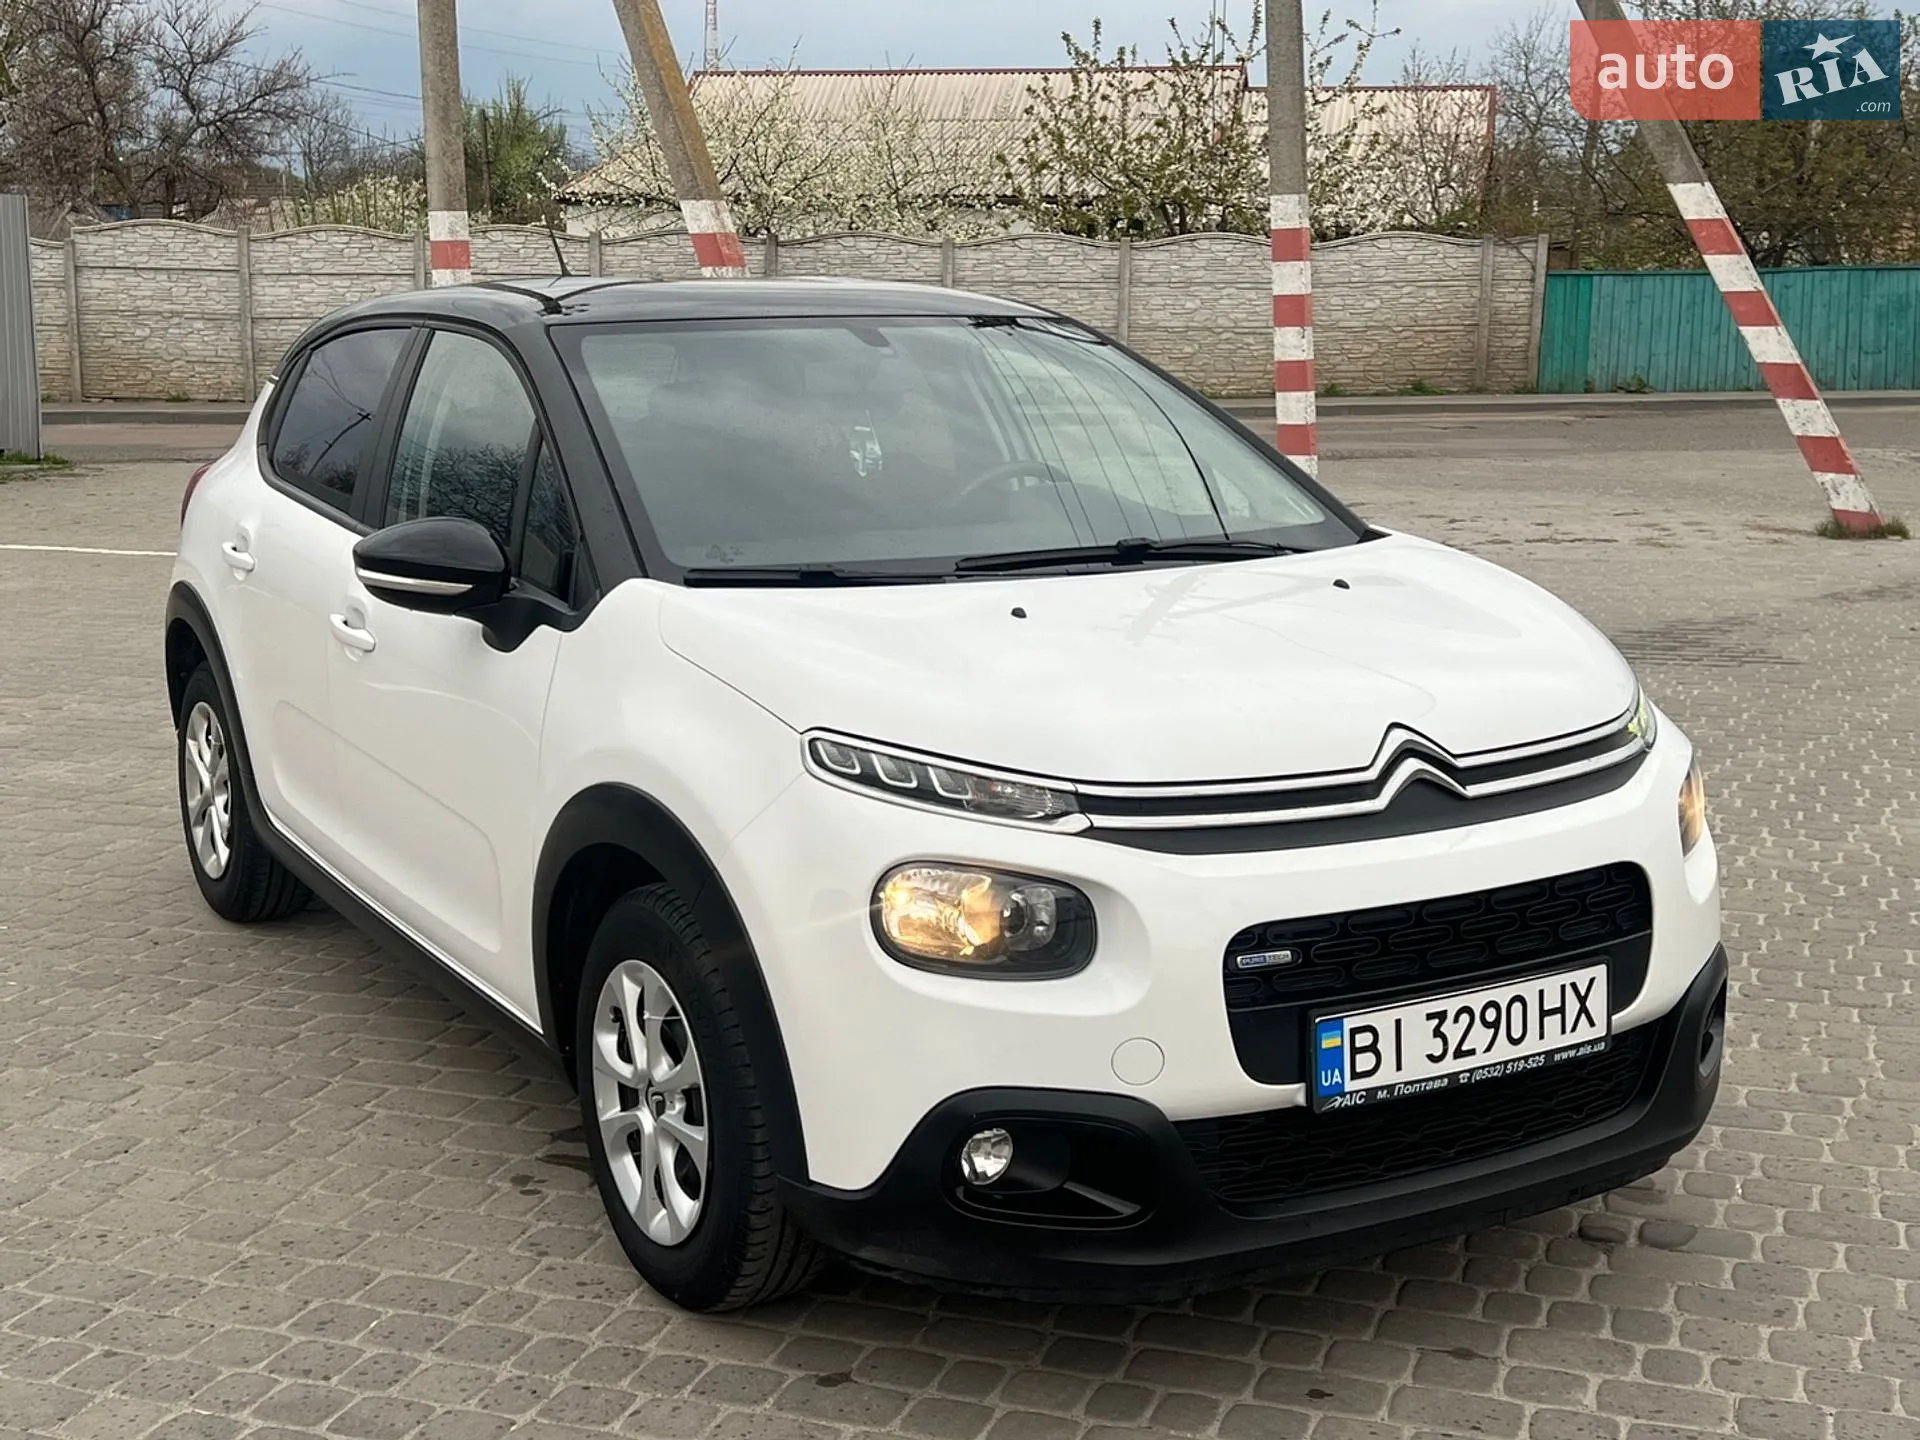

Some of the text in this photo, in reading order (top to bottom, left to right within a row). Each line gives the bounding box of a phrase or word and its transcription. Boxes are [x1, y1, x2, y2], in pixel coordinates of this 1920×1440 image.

[1425, 994, 1528, 1064] 3290
[1321, 1068, 1343, 1087] UA
[1394, 1078, 1449, 1097] Полтава
[1471, 1064, 1504, 1083] (0532)
[1554, 1042, 1605, 1062] www.ais.ua
